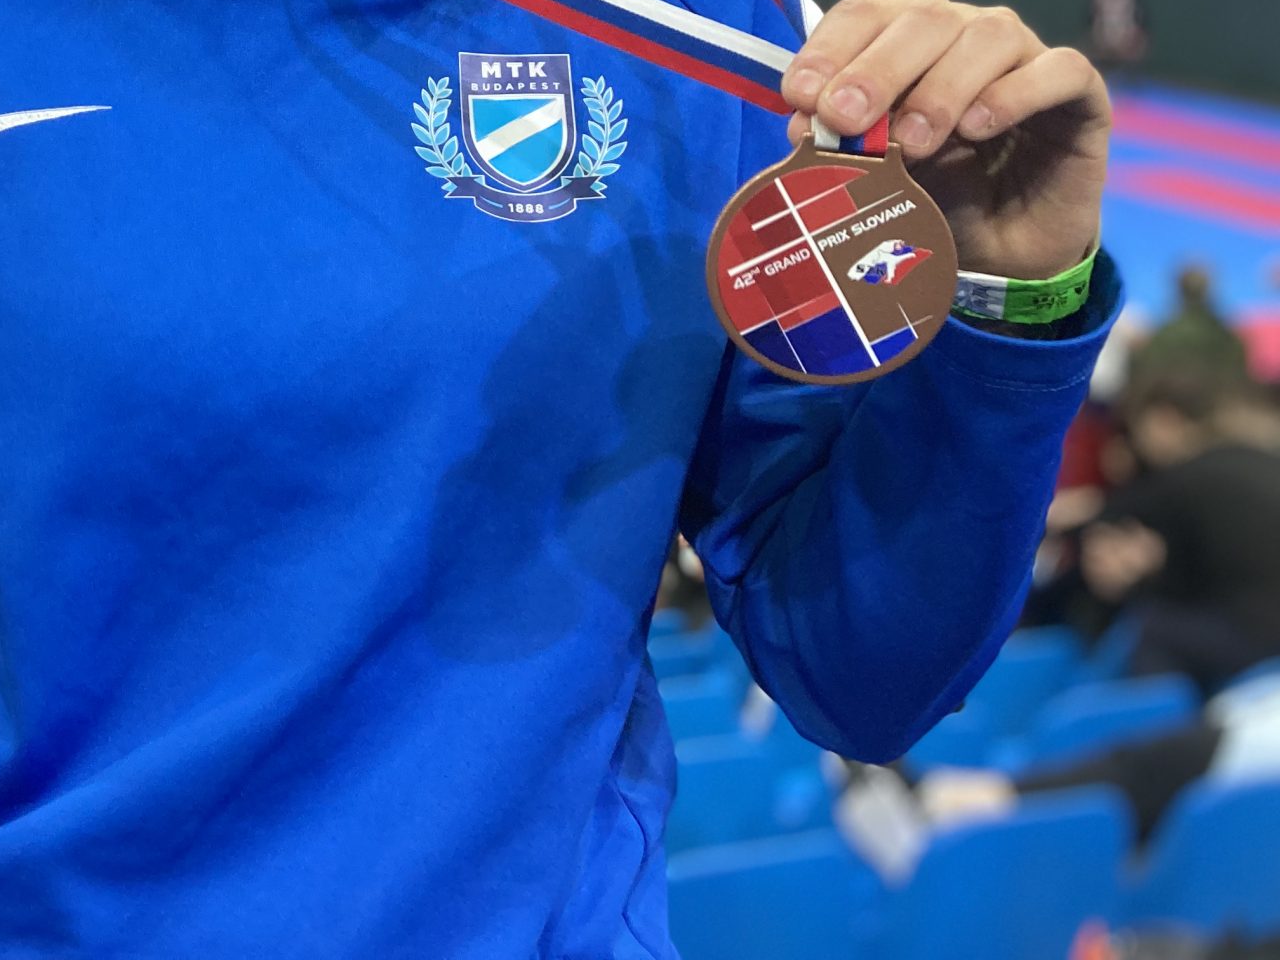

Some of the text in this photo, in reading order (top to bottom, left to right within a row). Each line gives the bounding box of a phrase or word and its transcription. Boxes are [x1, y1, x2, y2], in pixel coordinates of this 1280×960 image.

[481, 61, 547, 78] MTK
[471, 82, 561, 91] BUDAPEST
[508, 203, 544, 214] 1888
[764, 248, 811, 276] GRAND
[818, 230, 850, 252] PRIX
[852, 200, 916, 236] SLOVAKIA
